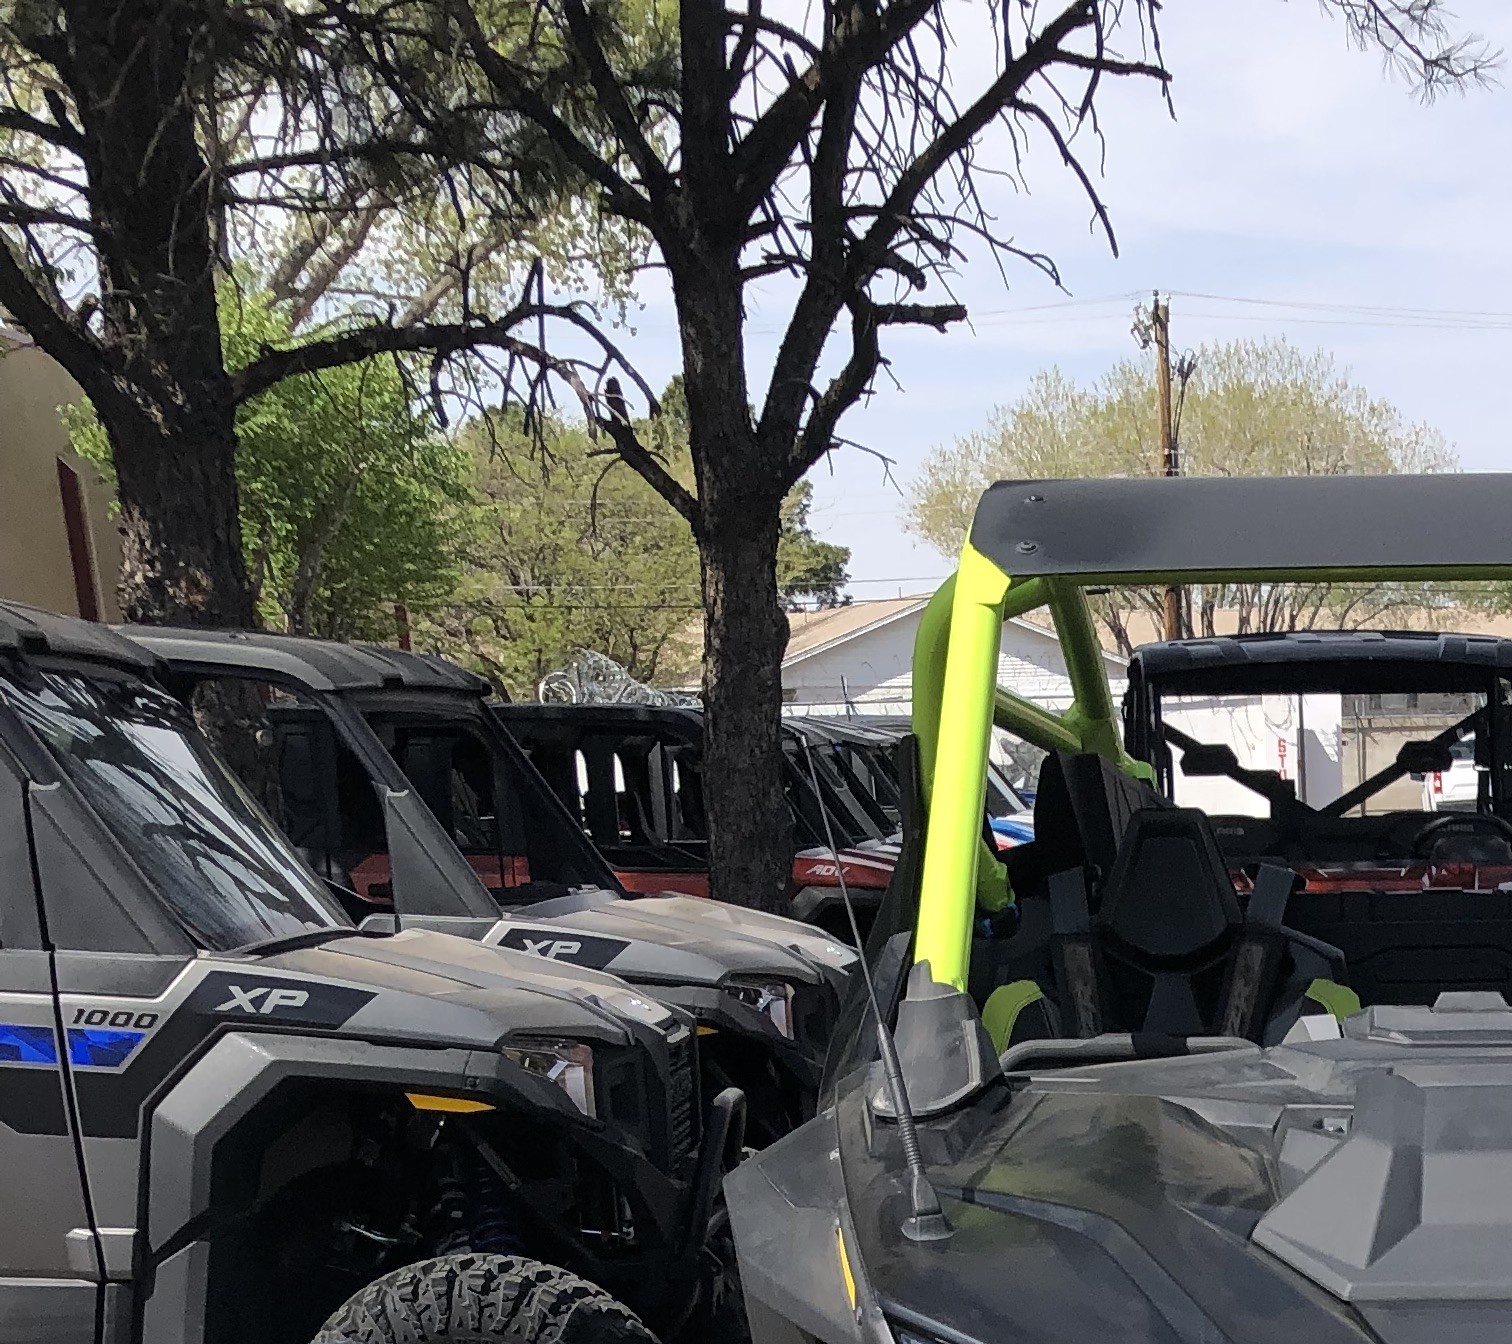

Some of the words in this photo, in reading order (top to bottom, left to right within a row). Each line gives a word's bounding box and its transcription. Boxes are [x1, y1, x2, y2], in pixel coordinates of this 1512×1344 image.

[1278, 738, 1287, 780] STO
[805, 864, 850, 877] ADV
[522, 938, 582, 960] XP
[213, 985, 310, 1015] XP
[71, 1008, 160, 1030] 1000
